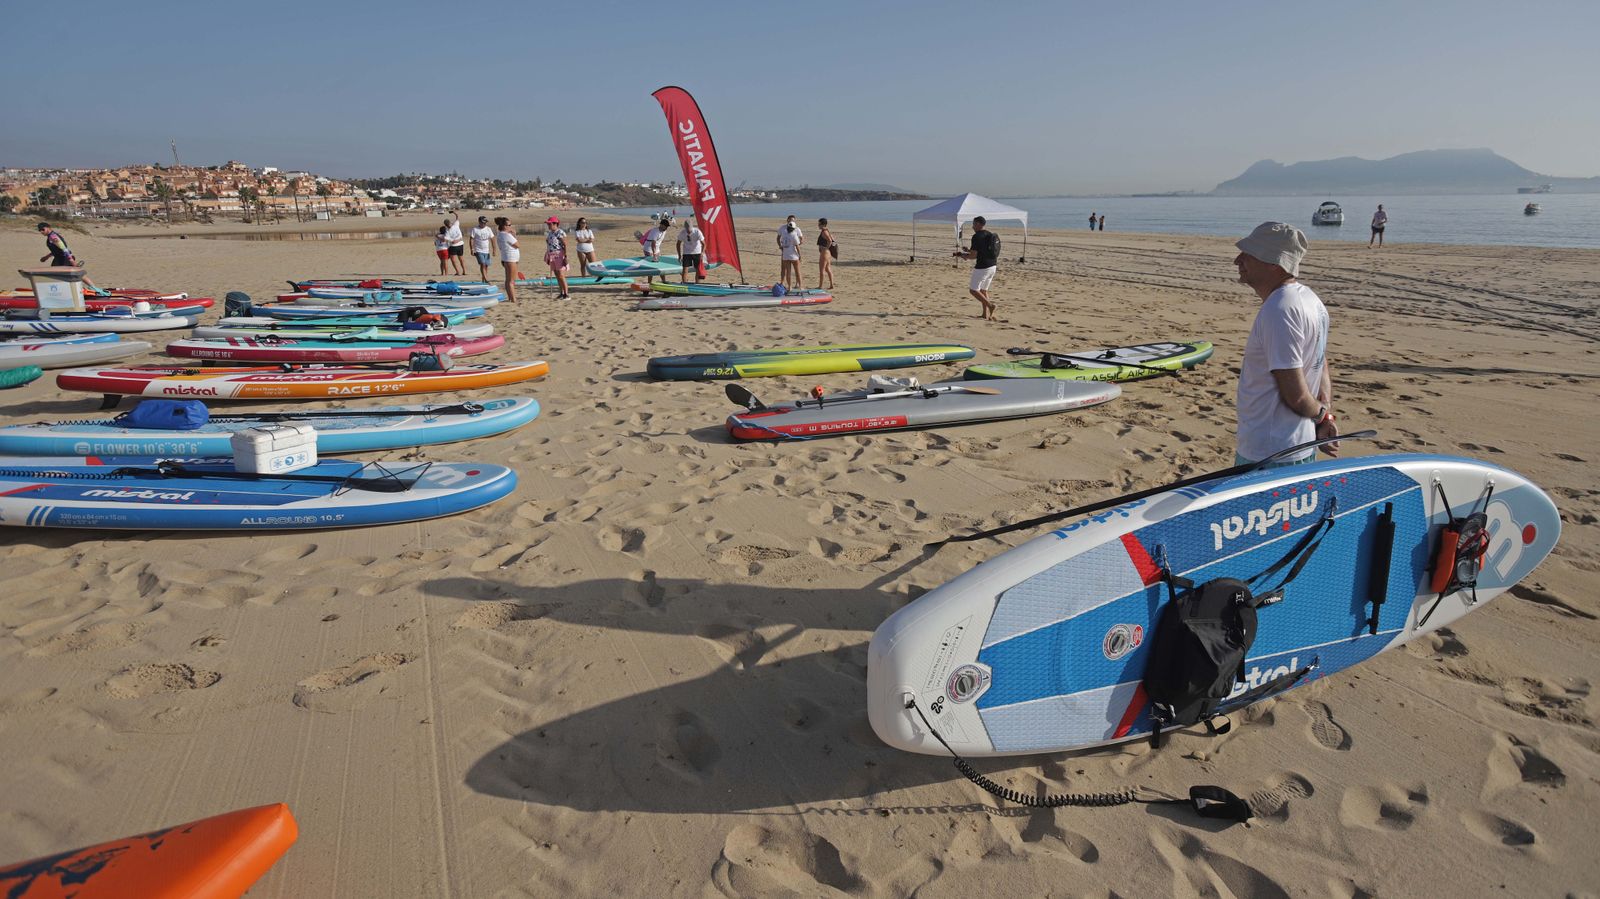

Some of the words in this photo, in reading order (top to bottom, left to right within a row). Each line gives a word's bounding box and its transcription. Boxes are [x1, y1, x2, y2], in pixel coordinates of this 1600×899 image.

[163, 385, 219, 397] mistral
[328, 385, 371, 395] RACE
[94, 443, 140, 455] FLOWER
[80, 487, 196, 501] mistral
[240, 515, 318, 525] ALLROUND
[1210, 490, 1319, 551] mistral
